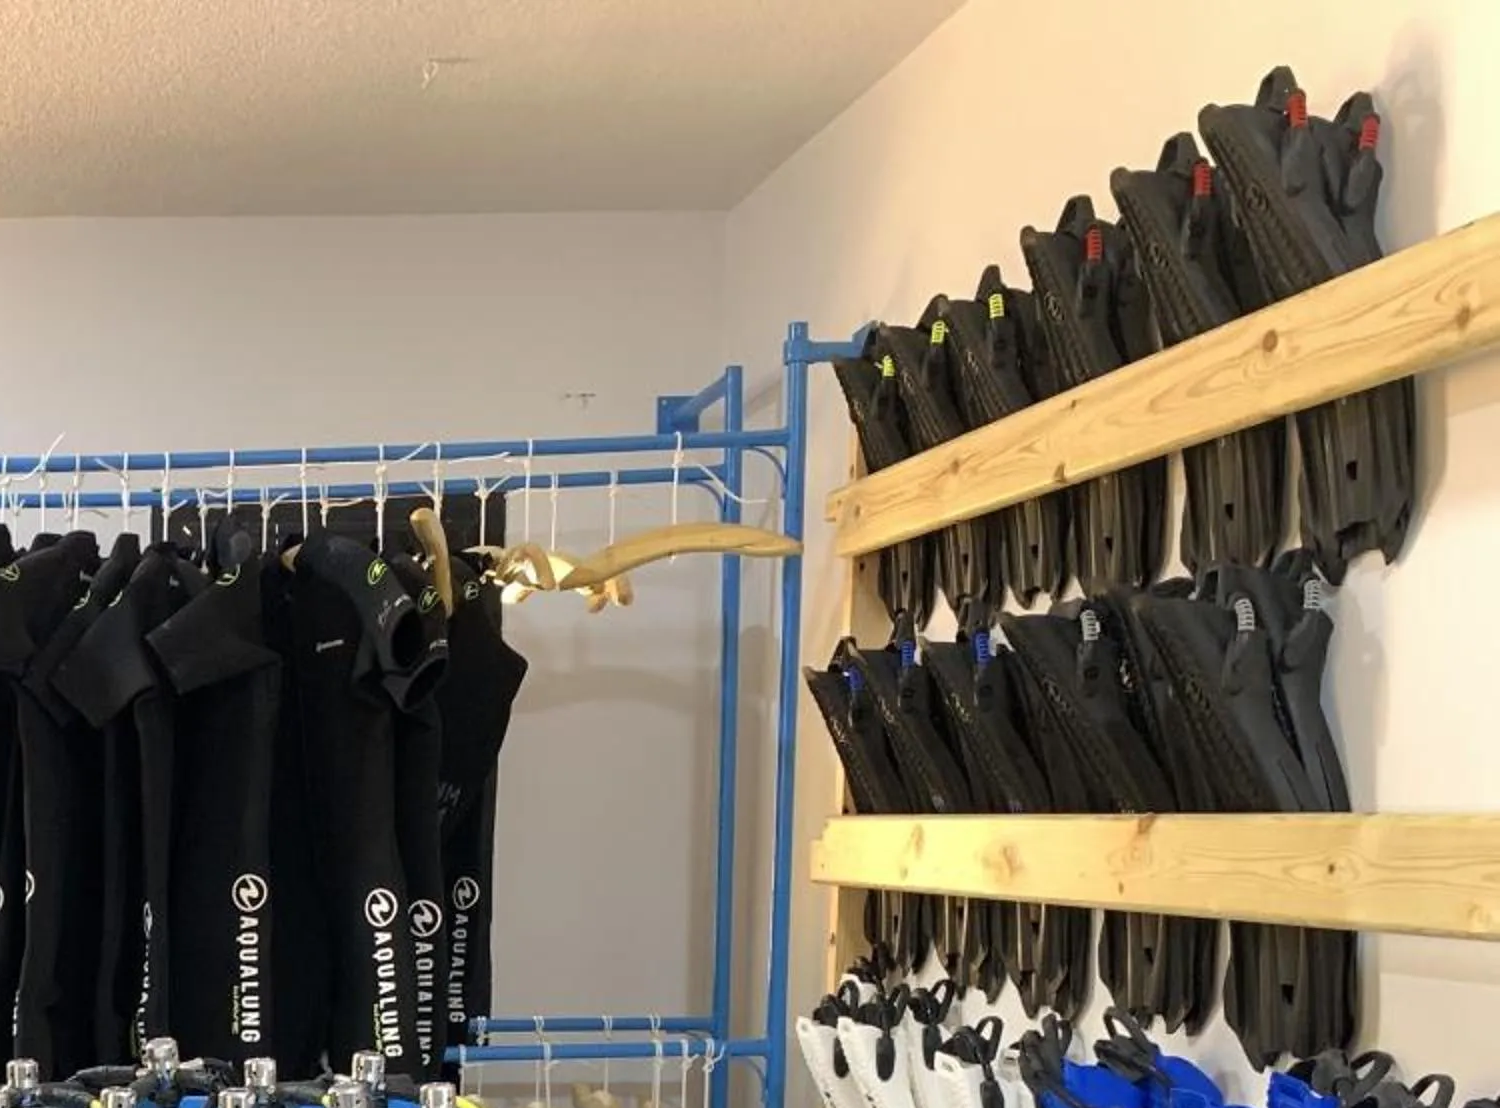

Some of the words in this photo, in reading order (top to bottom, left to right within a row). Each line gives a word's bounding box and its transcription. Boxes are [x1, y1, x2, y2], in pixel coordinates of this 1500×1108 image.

[236, 916, 261, 1043] AQUALUNG
[372, 931, 403, 1058] AQUALUNG
[448, 913, 469, 1024] AQUALUNG
